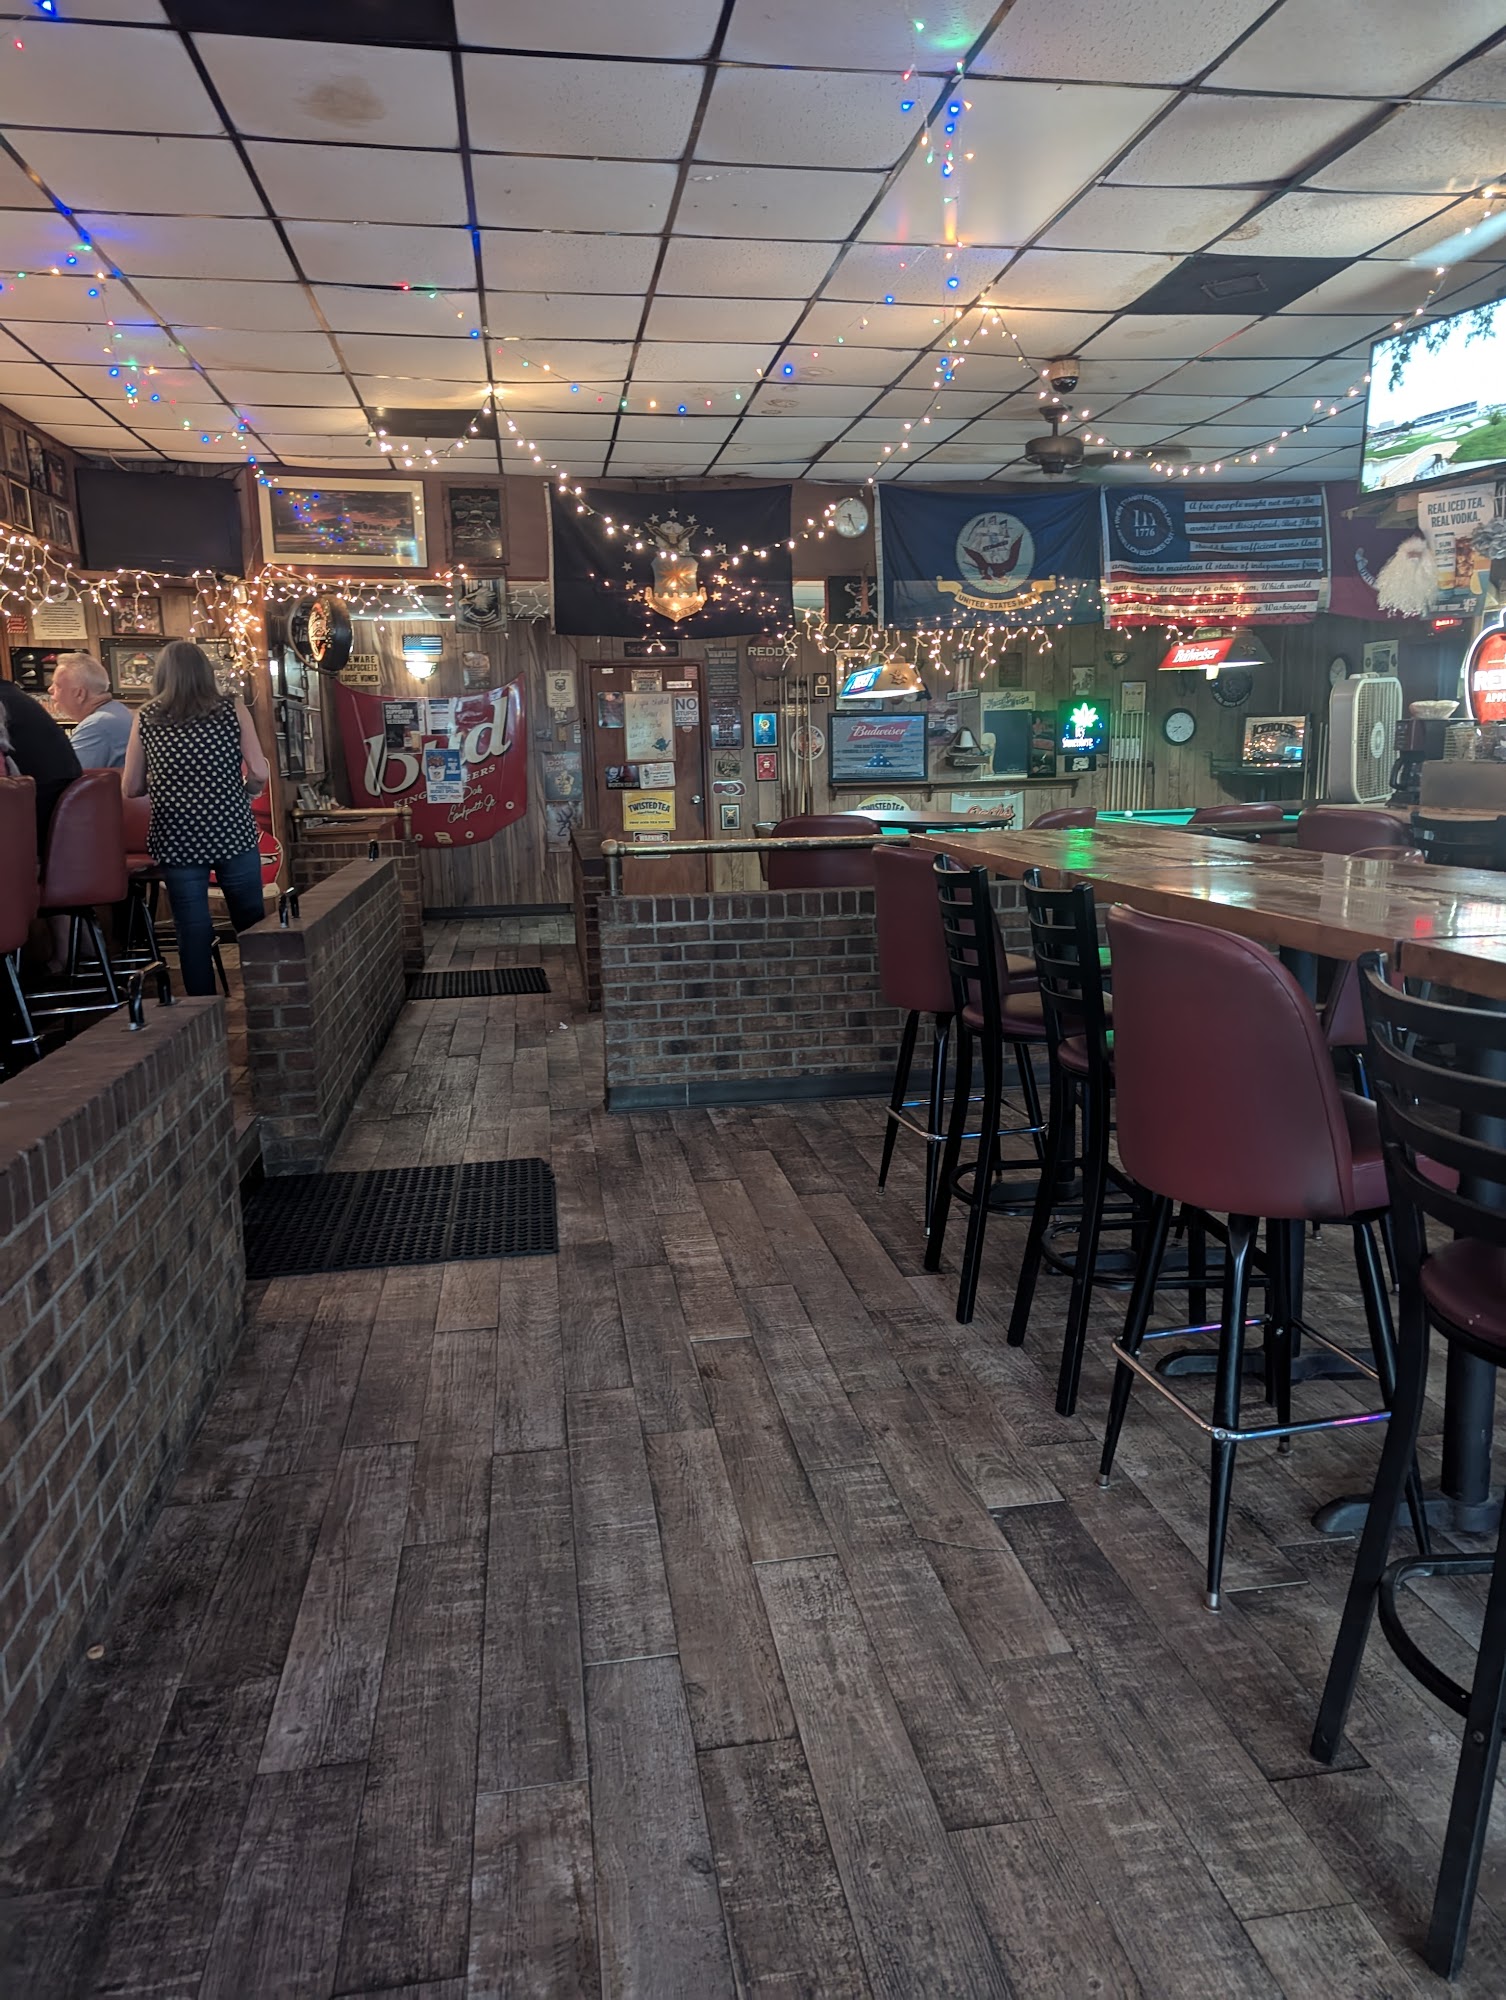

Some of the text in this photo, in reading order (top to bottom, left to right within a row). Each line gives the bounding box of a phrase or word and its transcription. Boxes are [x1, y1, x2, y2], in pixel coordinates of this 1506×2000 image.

[1199, 502, 1214, 511] free
[1427, 501, 1449, 516] REAL
[1448, 499, 1466, 513] ICED
[1467, 496, 1486, 510] TEA.
[1431, 511, 1481, 528] REAL VODKA.
[1135, 528, 1156, 537] 1776
[1217, 522, 1234, 531] and
[1166, 563, 1203, 571] maintain
[1215, 561, 1239, 570] status
[1240, 562, 1249, 571] of
[1250, 560, 1301, 570] independence
[1112, 584, 1129, 592] any
[1203, 584, 1212, 592] to
[1261, 581, 1286, 591] Which
[1286, 580, 1312, 590] would
[958, 594, 985, 609] UNITED
[988, 601, 1017, 610] STATES
[1112, 603, 1142, 613] include
[1263, 602, 1308, 612] Washington
[348, 655, 376, 663] EWARE
[1171, 647, 1220, 664] Budweiser
[675, 698, 698, 710] NO
[850, 725, 907, 738] Budweiser
[1252, 722, 1297, 738] ICEHOUSE
[393, 791, 427, 808] KING
[627, 801, 671, 813] TWISTED TEA
